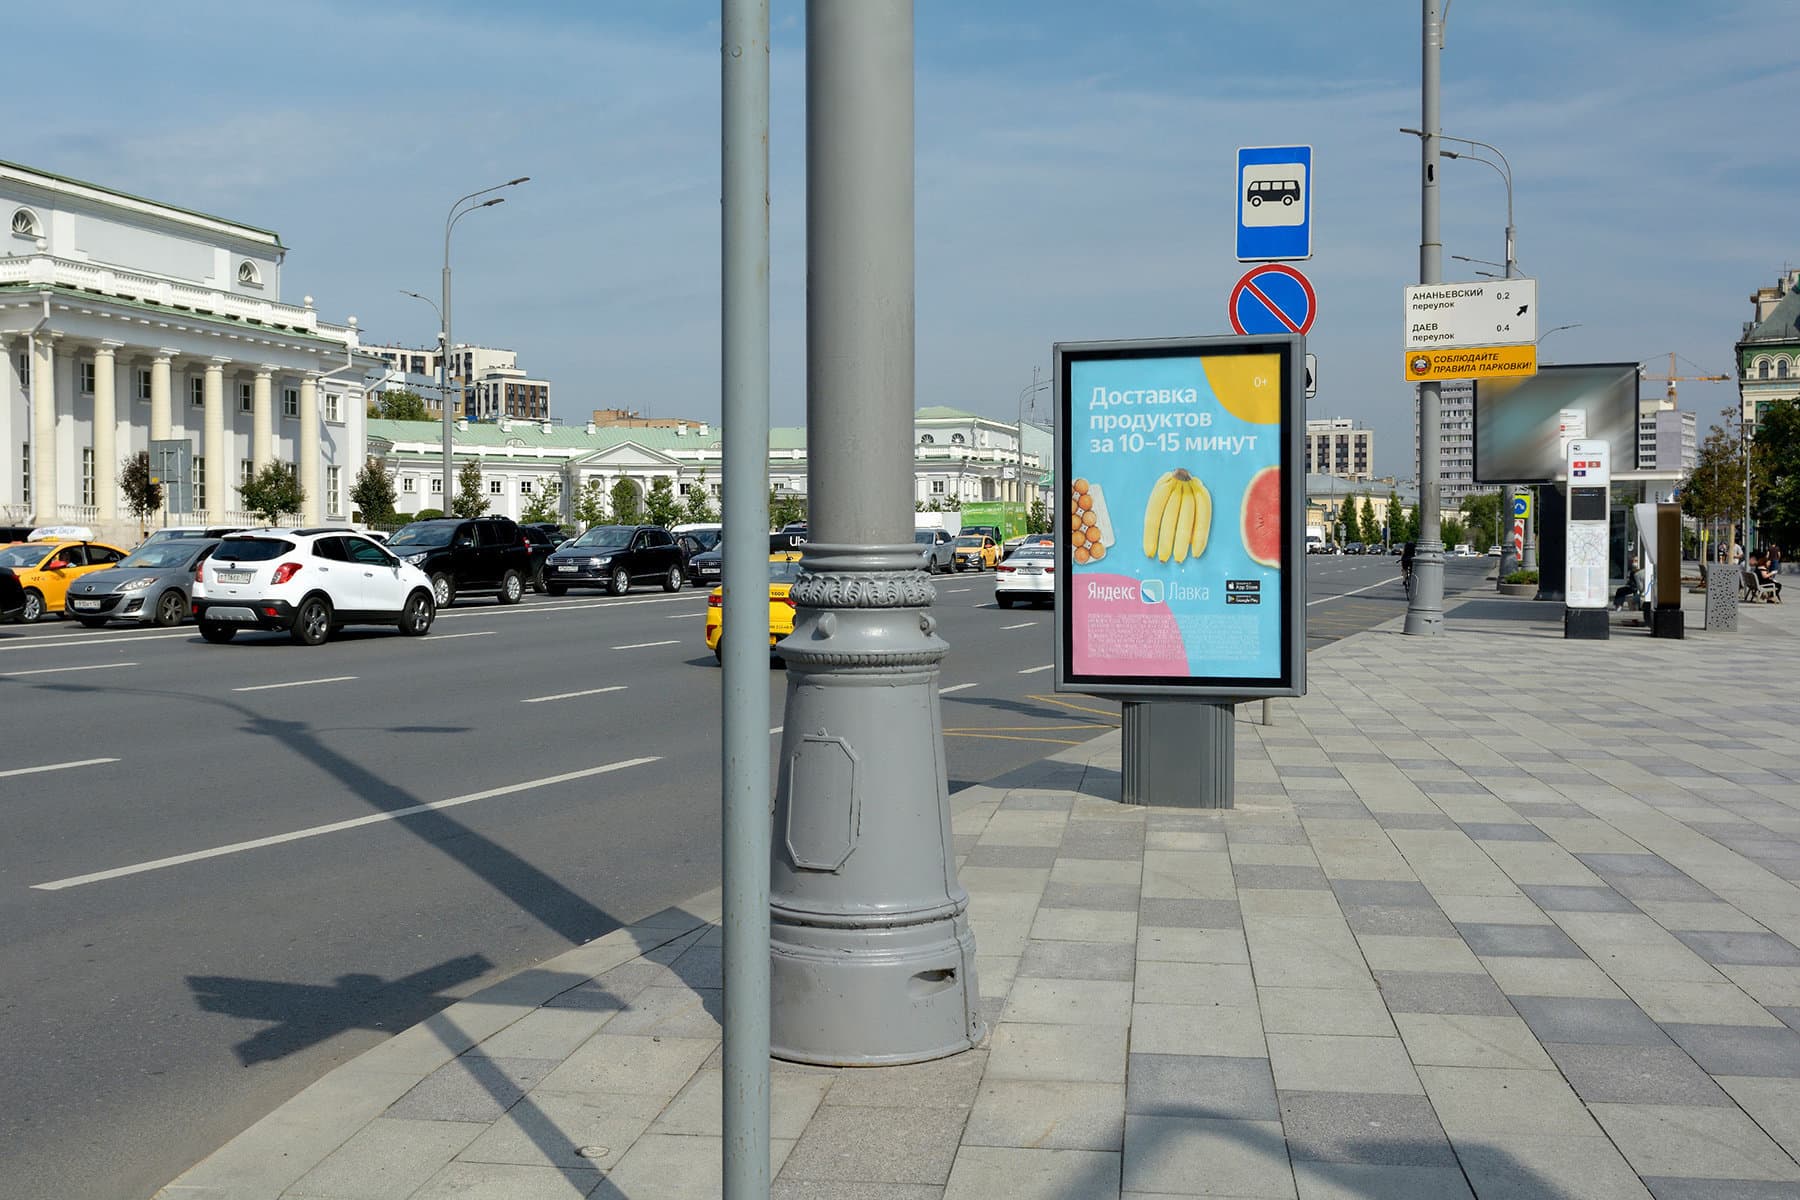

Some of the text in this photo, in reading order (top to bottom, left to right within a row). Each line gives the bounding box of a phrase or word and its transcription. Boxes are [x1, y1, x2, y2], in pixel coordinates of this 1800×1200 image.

[1412, 288, 1510, 301] АНАНЬЕВСКИЙ 0.2
[1412, 302, 1455, 311] переулок
[1412, 323, 1510, 332] ДАЕВ 0.4
[1412, 333, 1455, 342] переулок
[1433, 353, 1500, 363] СОБЛЮДАЙТЕ
[1433, 361, 1532, 373] ПРАВИЛА ПАРКОВКИ!
[1253, 376, 1268, 388] 0+
[1089, 386, 1197, 410] Доставка
[1090, 412, 1213, 433] продуктов
[1090, 438, 1114, 453] за
[1185, 435, 1258, 455] минут
[789, 535, 808, 547] Ub
[1087, 581, 1209, 602] Яндекс Лавка
